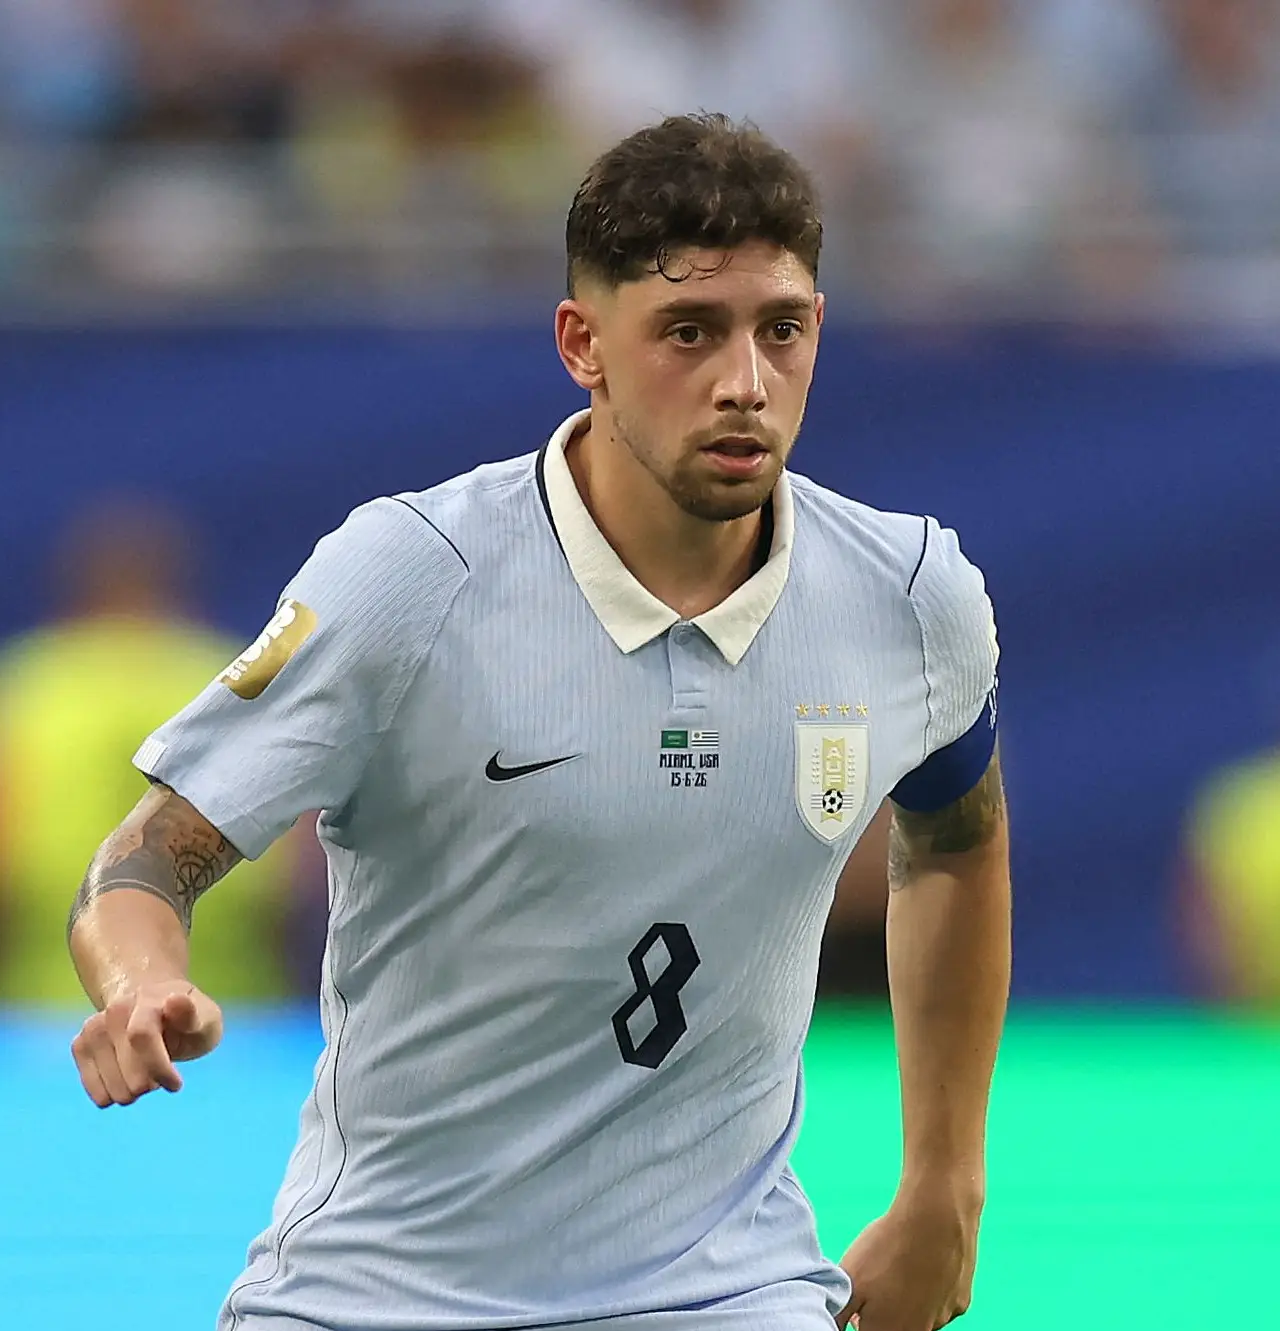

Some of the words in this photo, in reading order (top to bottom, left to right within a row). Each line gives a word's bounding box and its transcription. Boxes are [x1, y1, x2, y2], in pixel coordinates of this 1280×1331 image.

[659, 753, 696, 771] MIAMI,
[699, 753, 719, 769] USA
[611, 922, 701, 1070] 8
